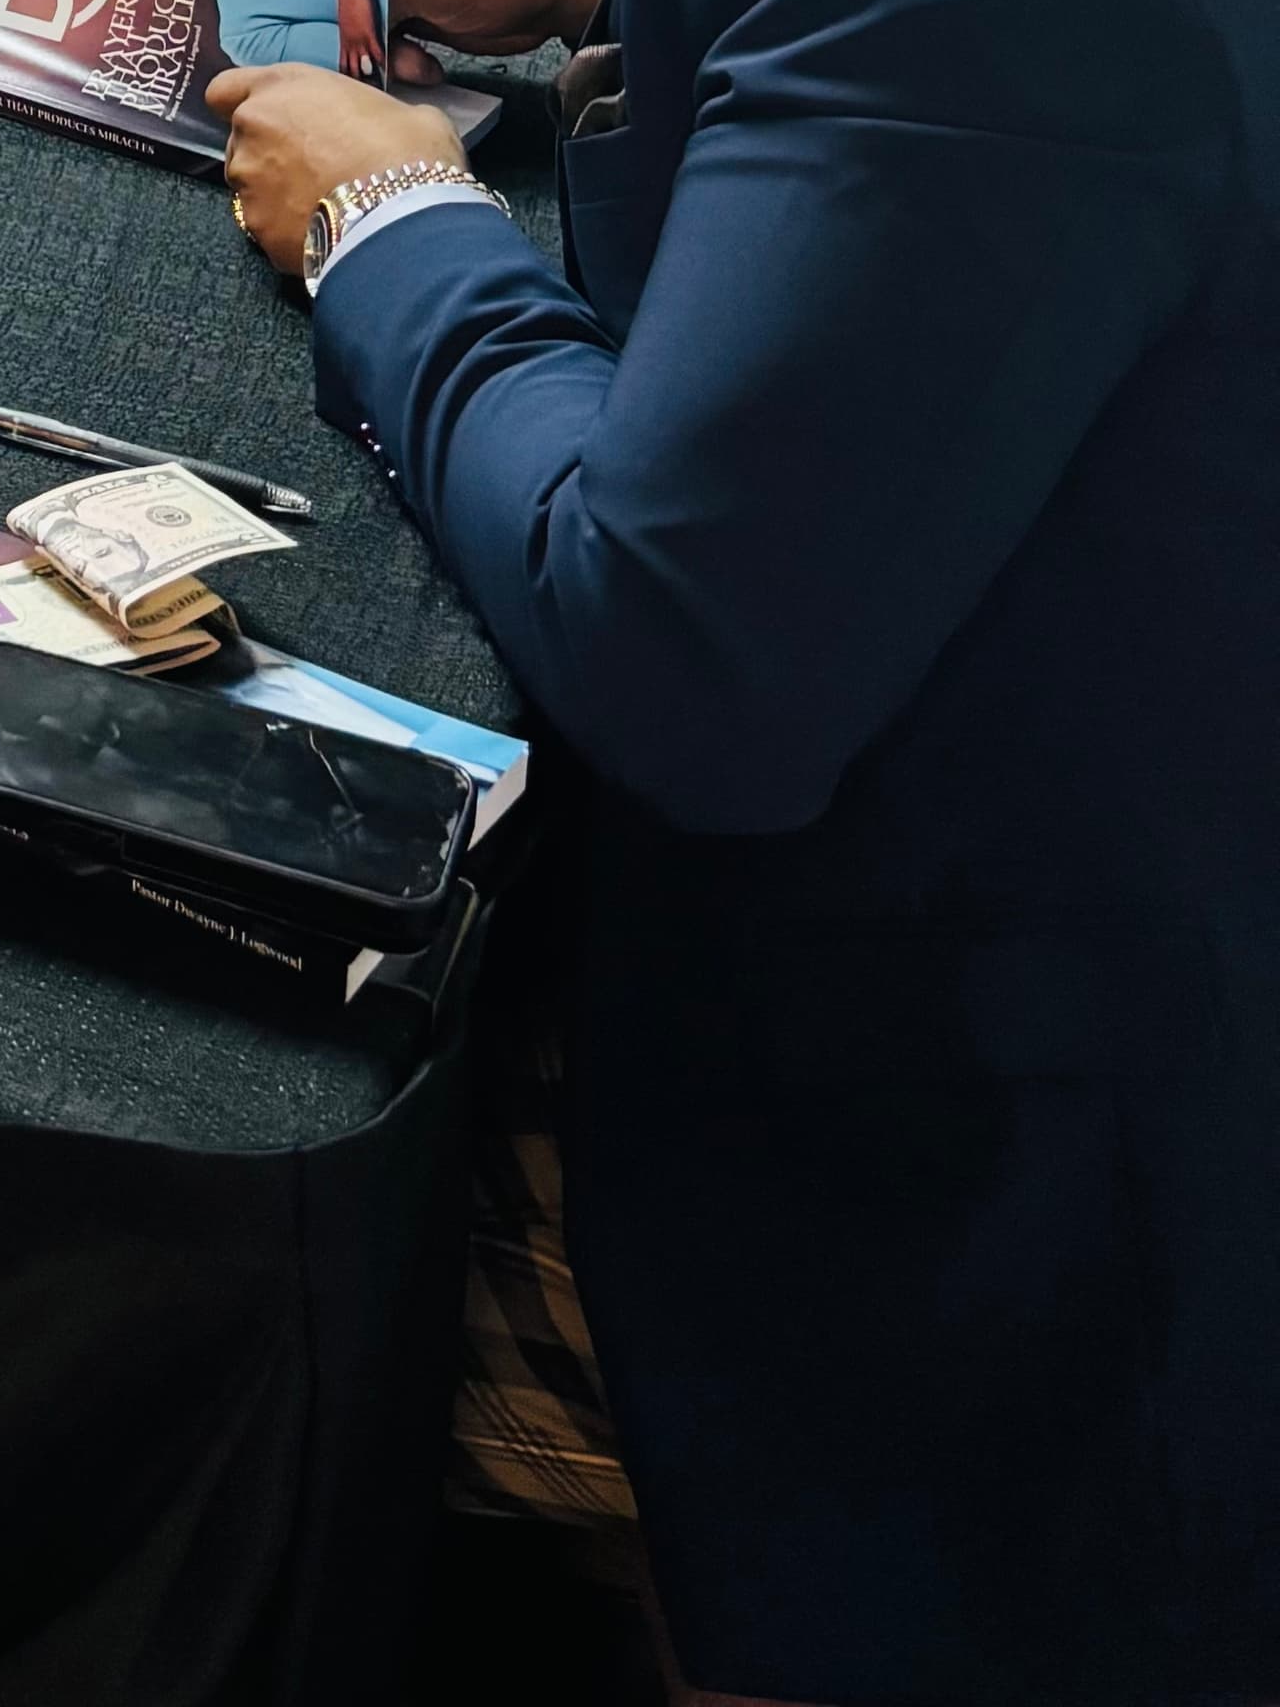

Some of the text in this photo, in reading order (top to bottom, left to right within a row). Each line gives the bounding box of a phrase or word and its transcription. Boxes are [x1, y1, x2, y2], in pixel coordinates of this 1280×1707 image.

[103, 35, 146, 106] THAT
[5, 97, 34, 117] THAT
[97, 128, 156, 156] MIRACLES
[131, 878, 172, 909] Pastor
[174, 899, 226, 935] Dwayne
[241, 930, 303, 972] Logwood
